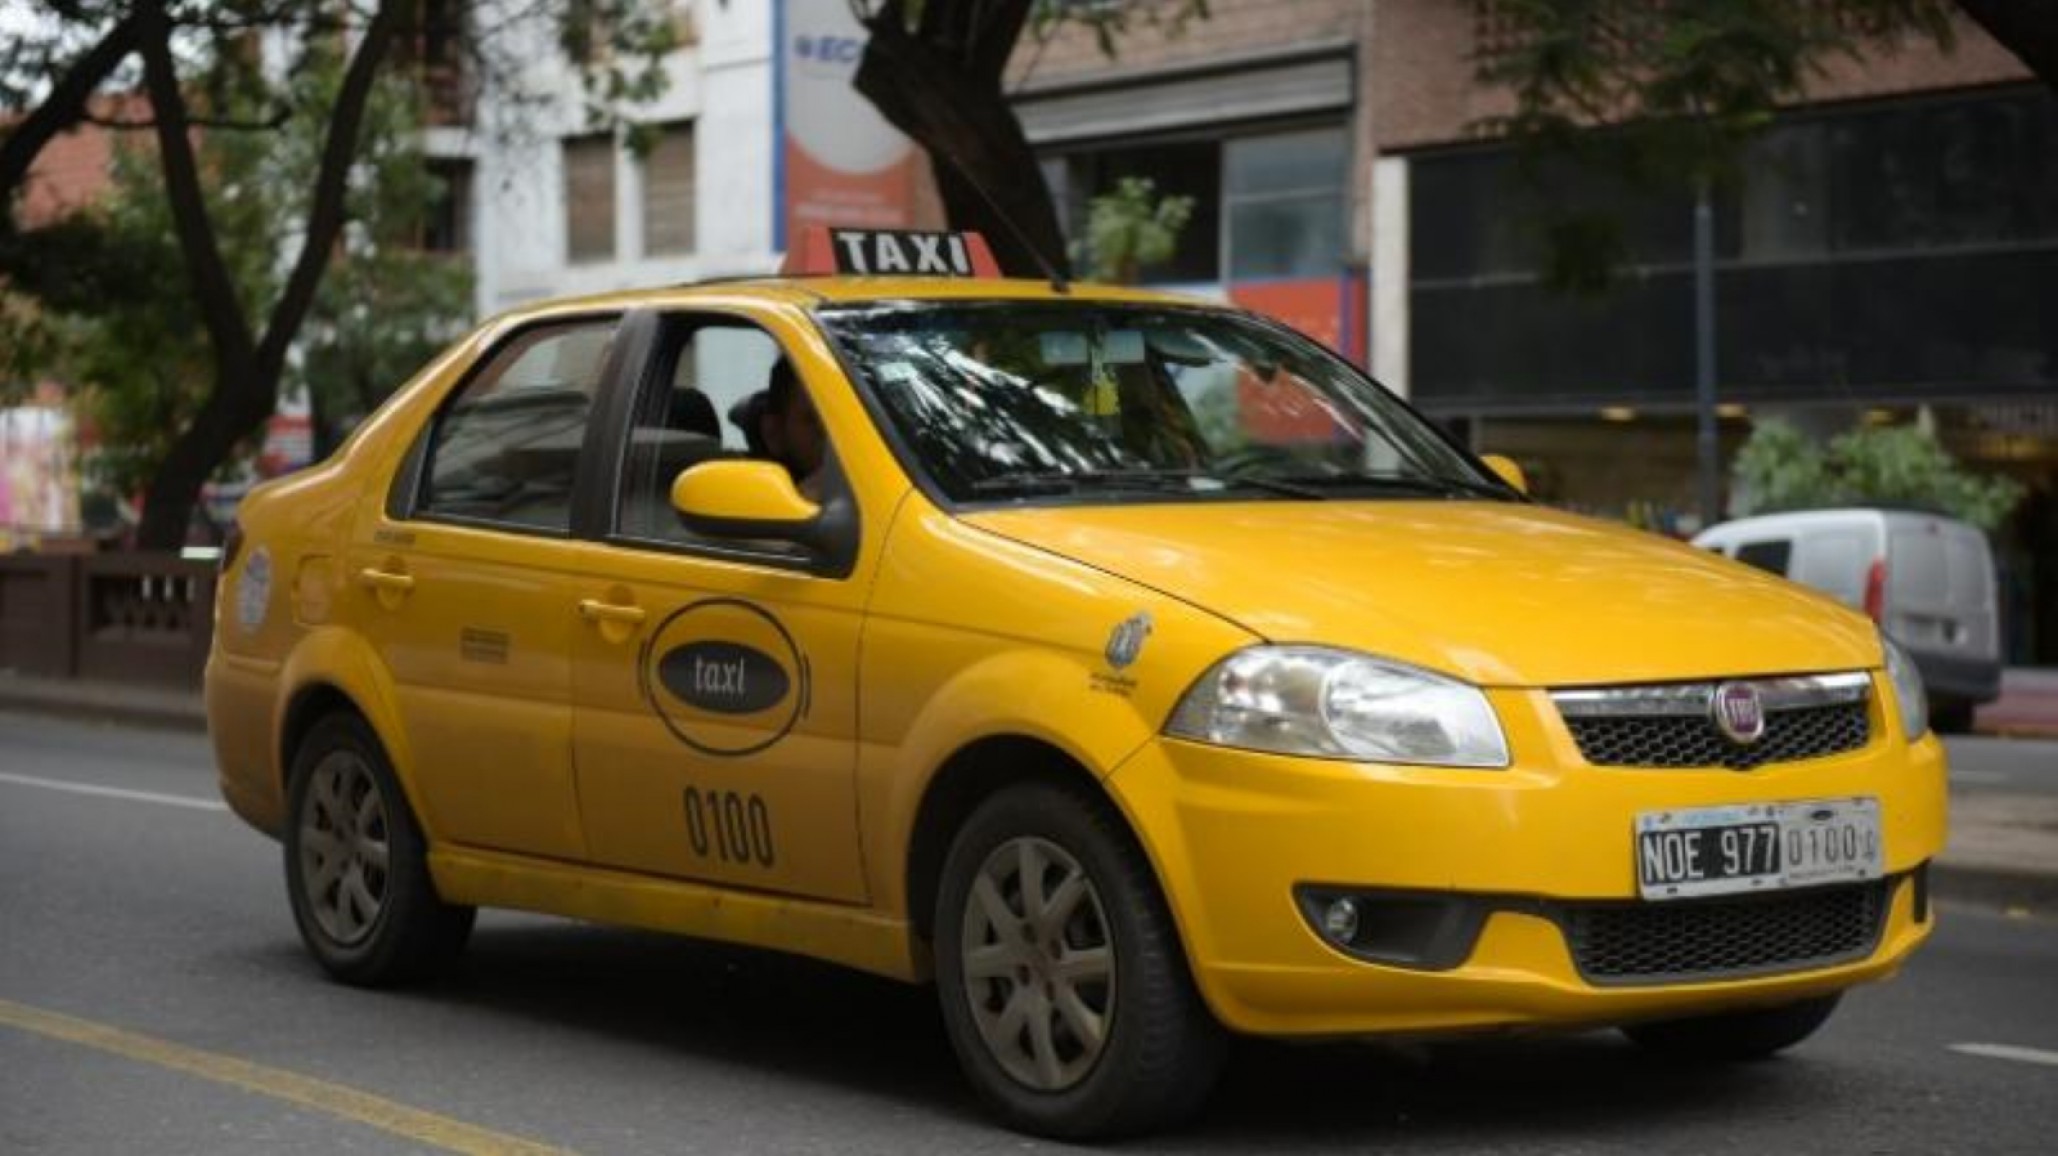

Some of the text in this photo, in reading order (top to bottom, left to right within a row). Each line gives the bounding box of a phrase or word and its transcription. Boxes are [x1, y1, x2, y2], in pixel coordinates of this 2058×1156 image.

[836, 231, 970, 274] TAXI
[695, 655, 746, 694] taxi
[683, 785, 774, 871] 0100
[1786, 823, 1857, 866] 0100
[1643, 825, 1776, 880] NOE 977
